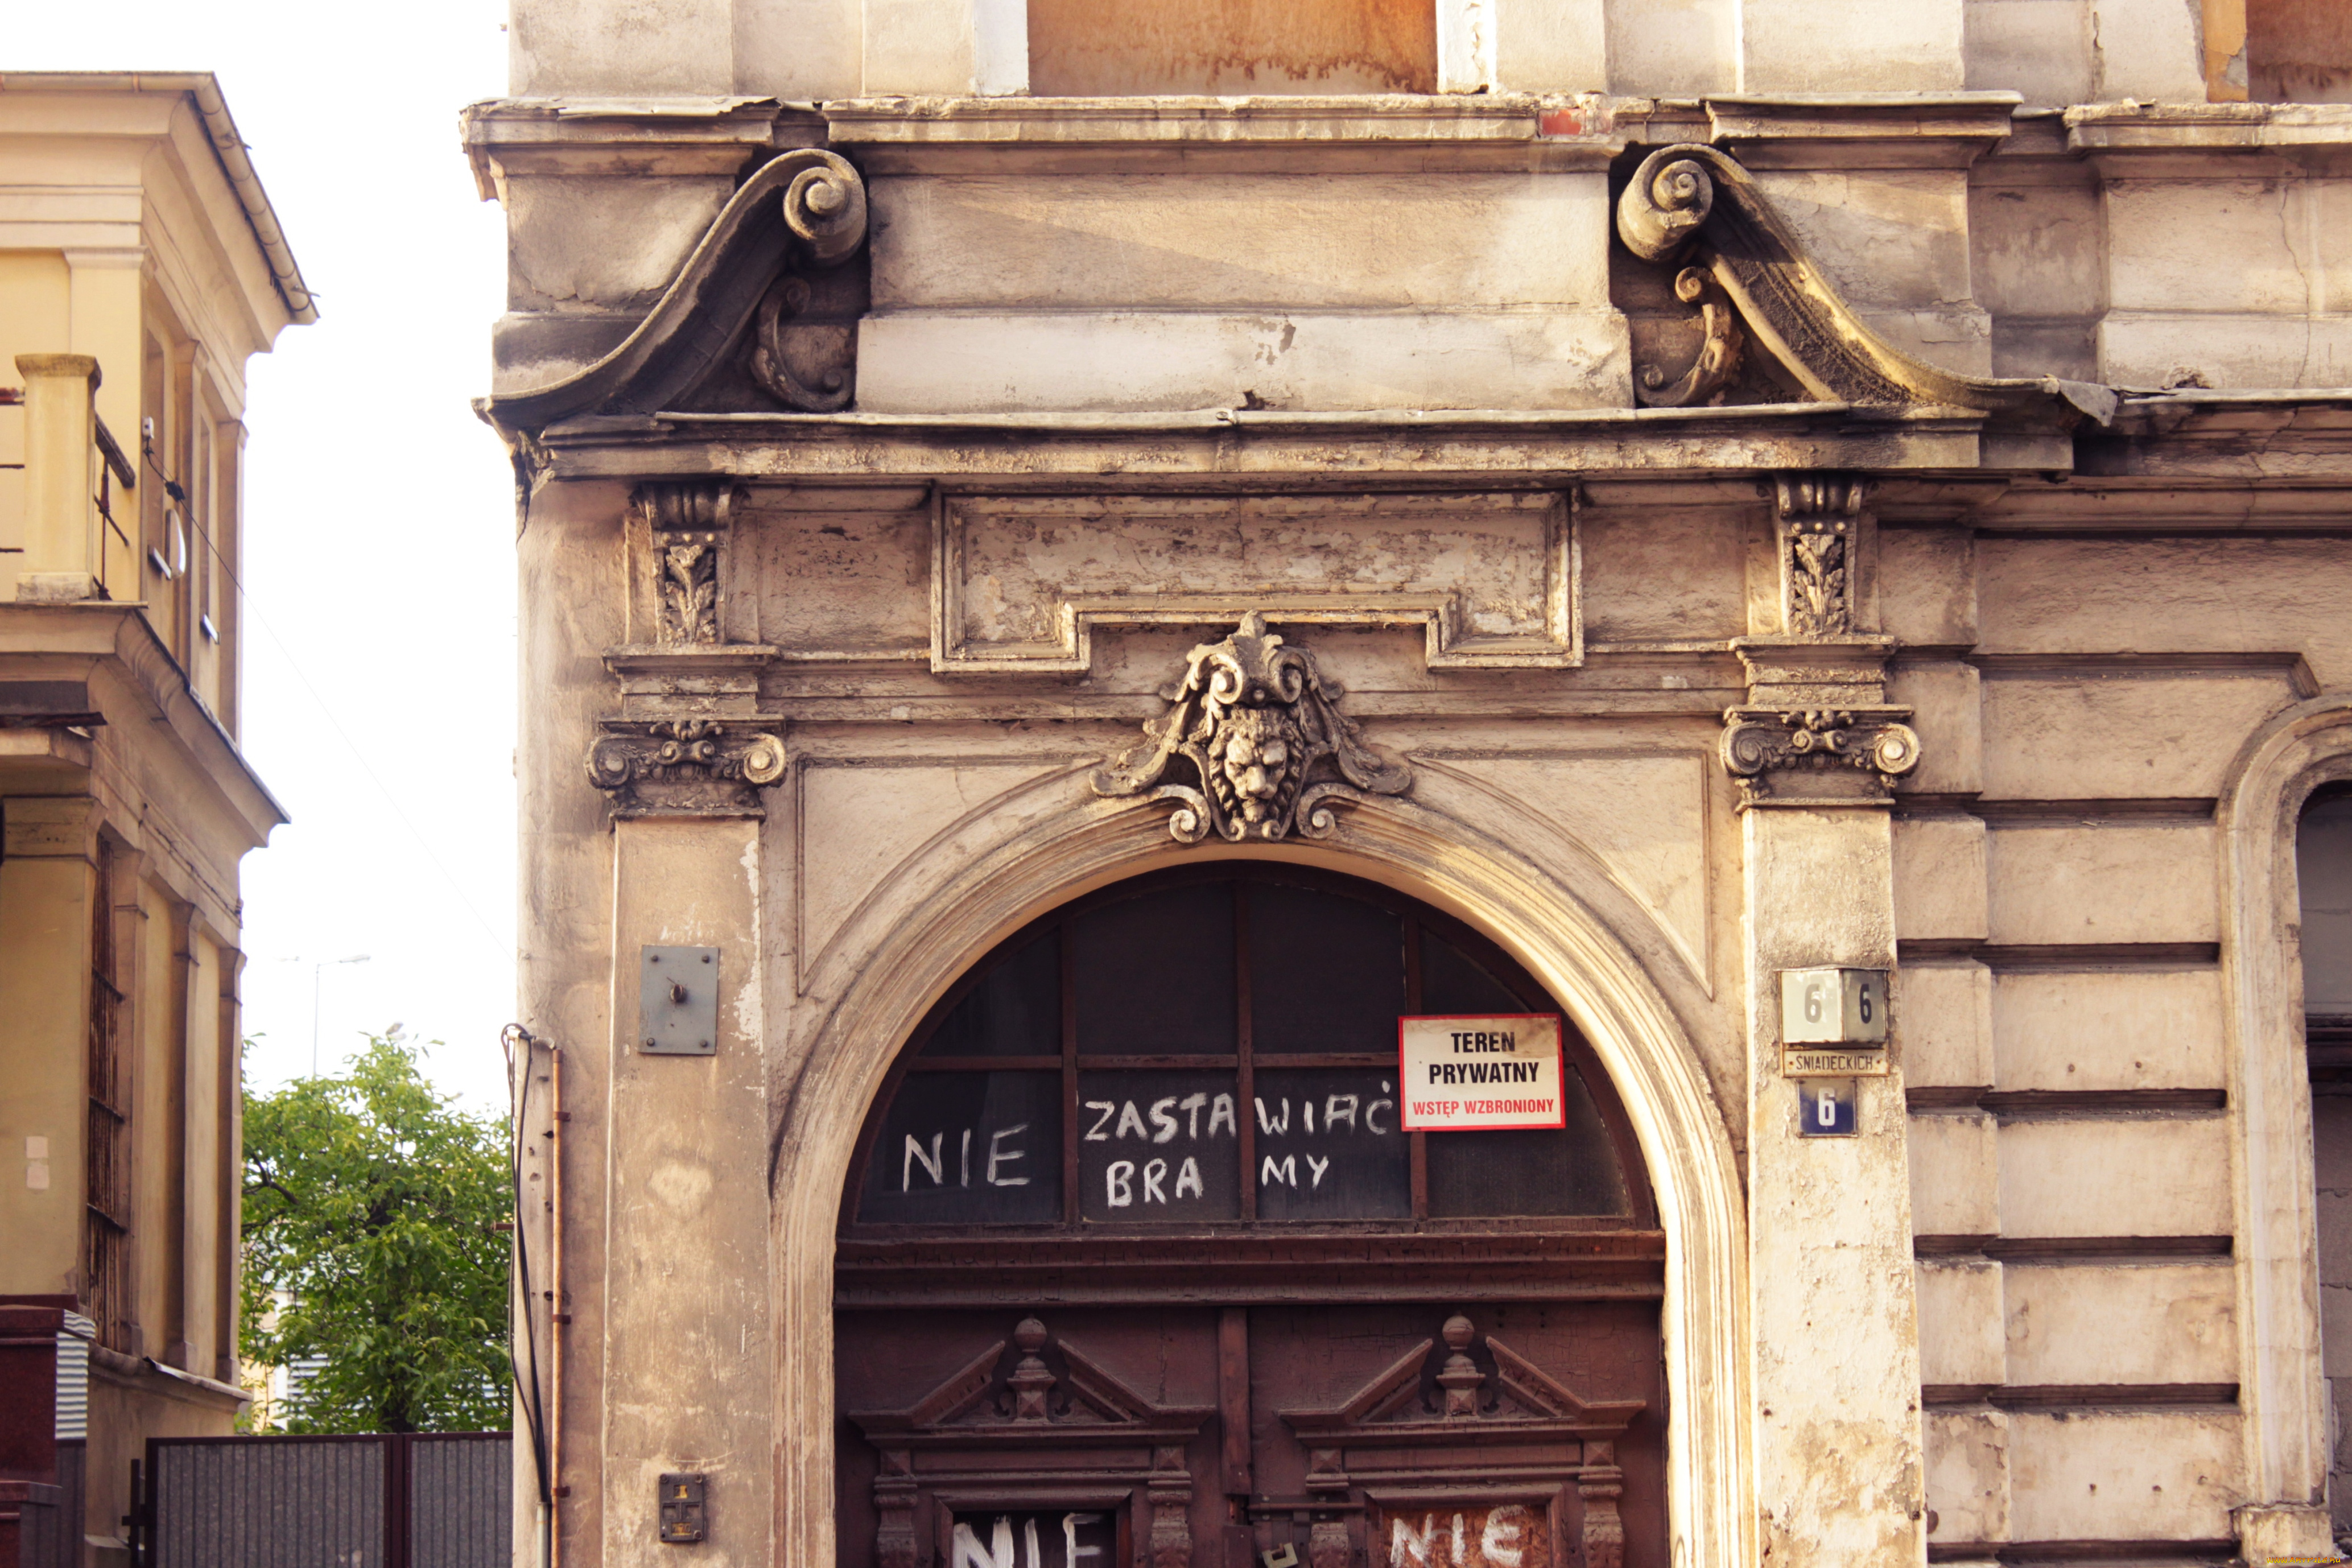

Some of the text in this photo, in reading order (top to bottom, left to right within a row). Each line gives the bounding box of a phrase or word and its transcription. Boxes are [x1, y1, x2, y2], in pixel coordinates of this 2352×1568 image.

[1805, 983, 1821, 1024] 6
[1859, 983, 1872, 1024] 6
[1451, 1031, 1515, 1053] TEREN
[1796, 1054, 1873, 1070] ŚNIADECKICH
[1429, 1062, 1540, 1084] PRYWATNY
[1413, 1099, 1554, 1118] WSTĘP WZBRONIONY
[1818, 1087, 1836, 1127] 6
[903, 1121, 1030, 1192] NIE
[1390, 1504, 1527, 1568] NIE
